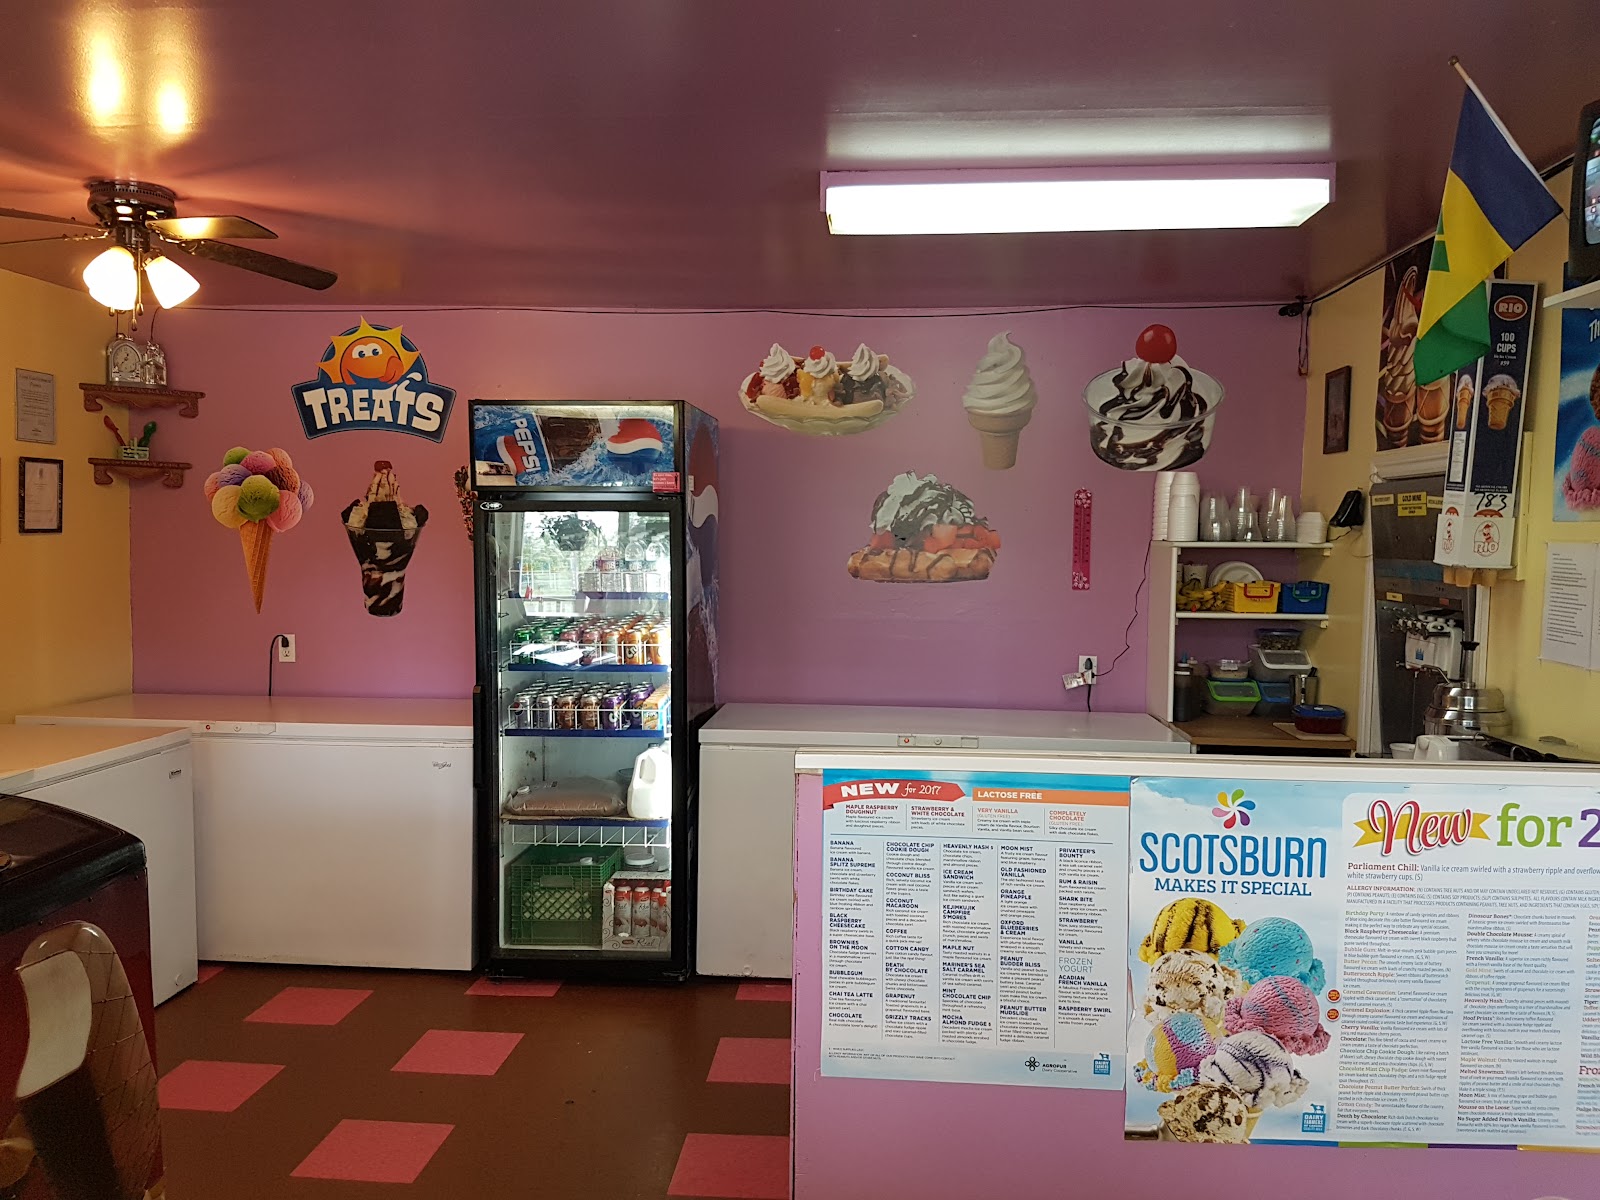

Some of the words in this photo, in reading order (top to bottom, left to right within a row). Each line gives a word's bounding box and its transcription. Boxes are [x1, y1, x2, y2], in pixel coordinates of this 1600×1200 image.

[1498, 302, 1524, 314] RIO
[1500, 332, 1515, 342] 100
[1496, 342, 1517, 353] CUPS
[302, 375, 444, 432] TREATS
[509, 418, 542, 473] PEPSI
[1474, 491, 1507, 512] 783
[1474, 541, 1500, 553] RIO
[841, 782, 900, 798] NEW
[901, 782, 916, 796] for
[918, 784, 942, 795] 2017
[978, 791, 1018, 799] LACTOSE
[1369, 799, 1472, 856] New
[1496, 802, 1572, 847] for
[1140, 832, 1327, 878] SCOTSBURN
[1348, 862, 1396, 871] Parliament
[1398, 863, 1419, 872] Chill:
[1512, 866, 1544, 875] strawberry
[1546, 866, 1562, 875] ripple
[1366, 872, 1398, 881] strawberry
[1154, 878, 1216, 894] MAKES
[1220, 880, 1238, 894] IT
[1240, 881, 1312, 896] SPECIAL
[1059, 957, 1093, 966] FROZEN
[1059, 965, 1092, 973] YOGURT
